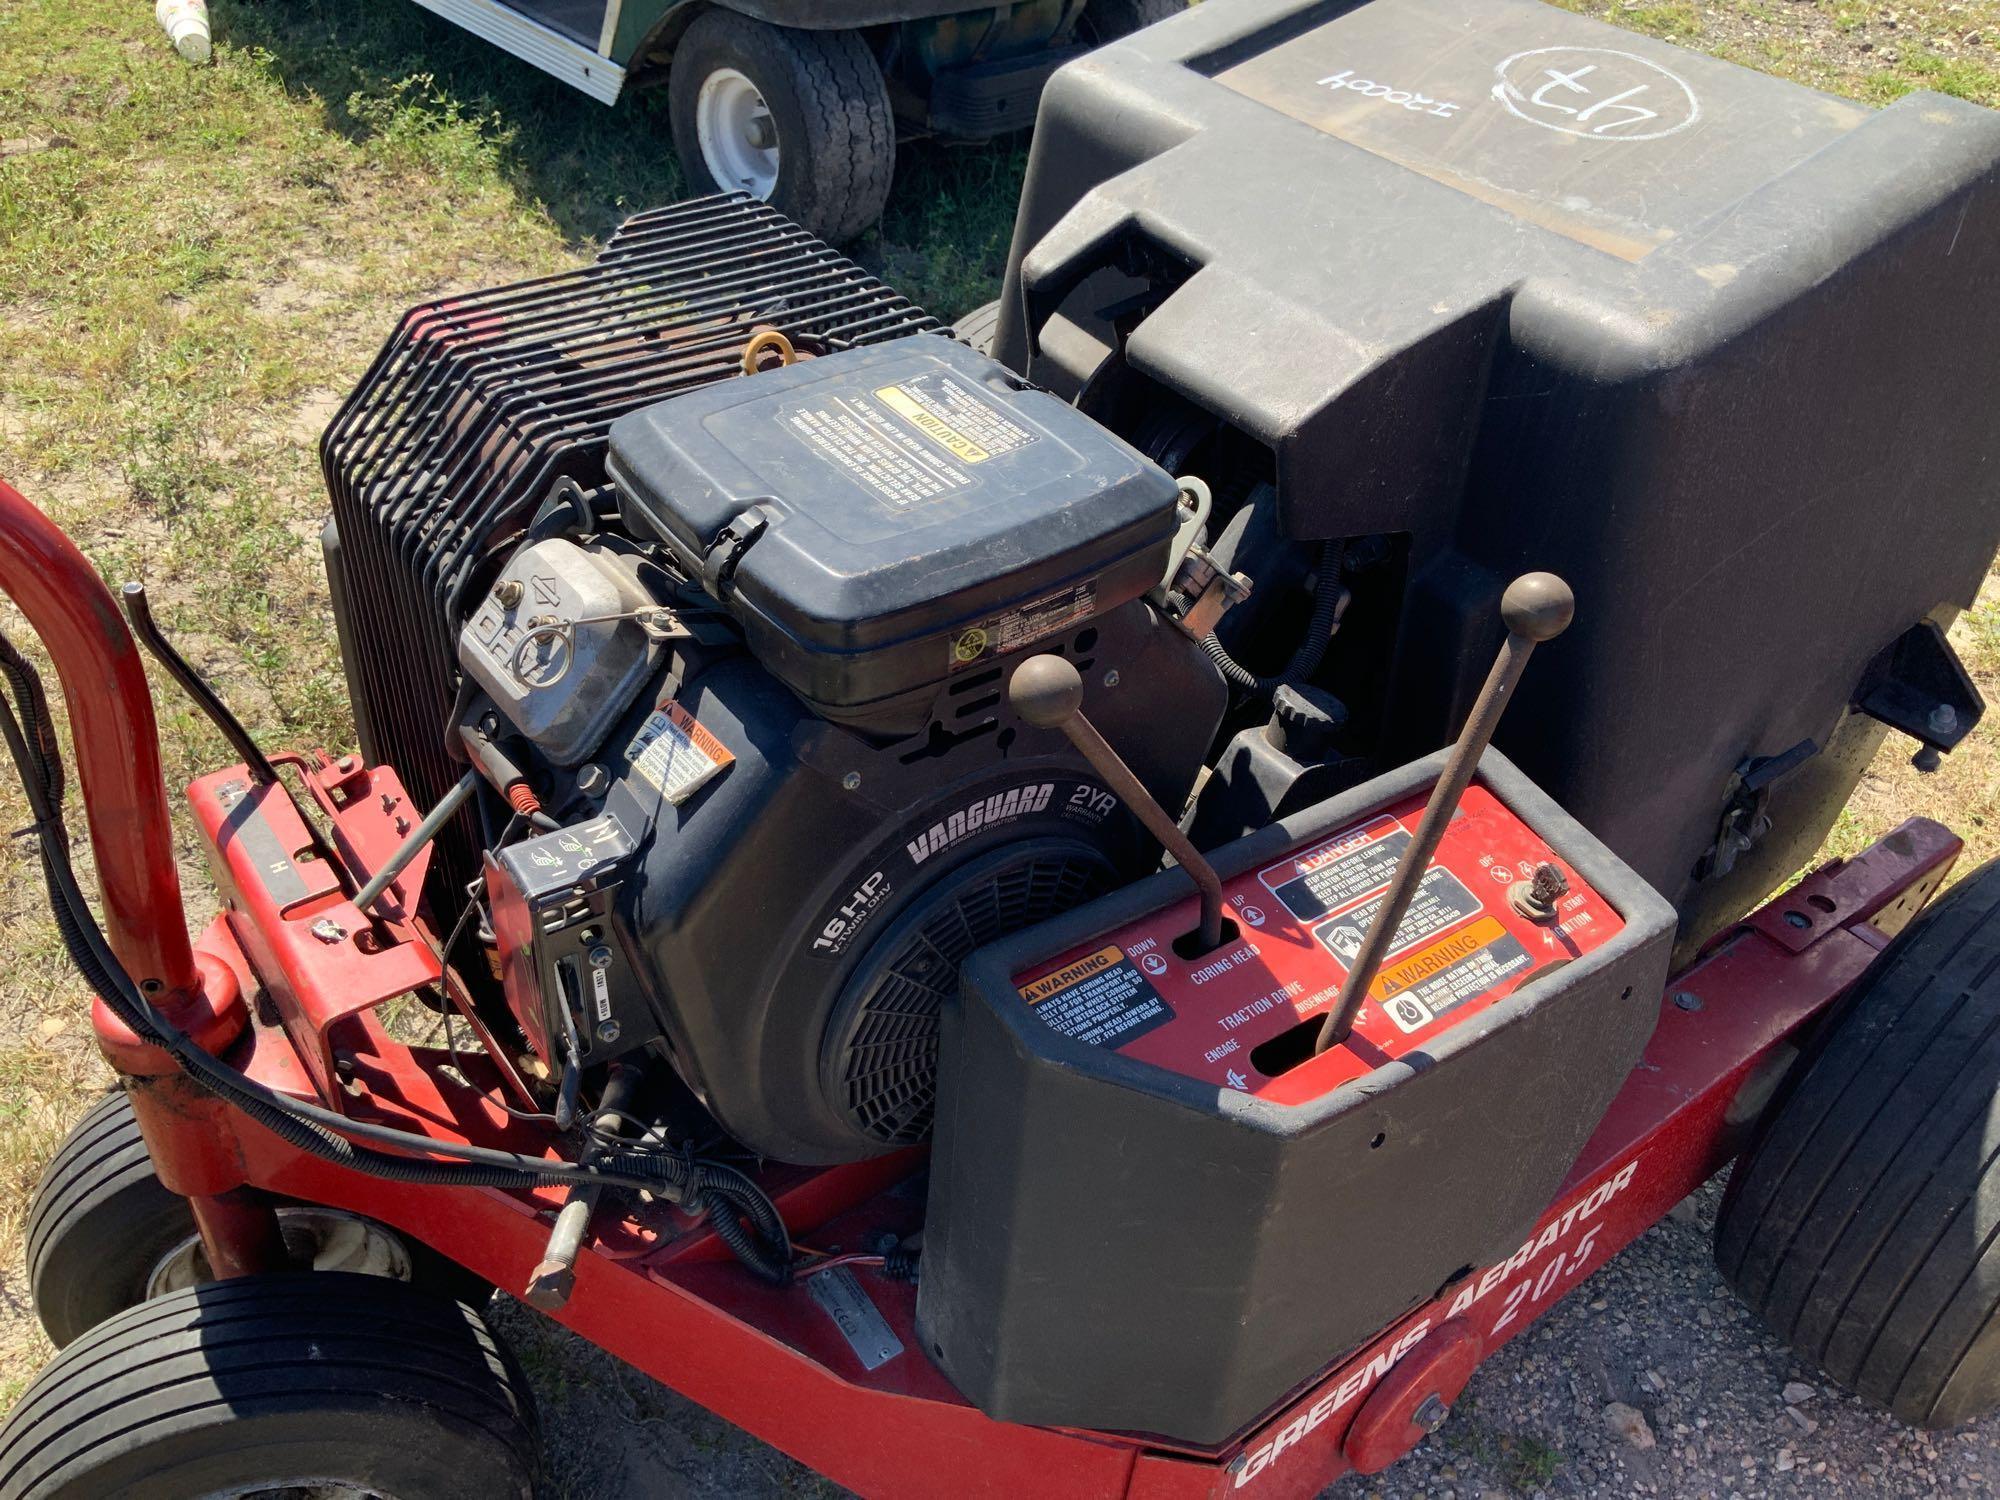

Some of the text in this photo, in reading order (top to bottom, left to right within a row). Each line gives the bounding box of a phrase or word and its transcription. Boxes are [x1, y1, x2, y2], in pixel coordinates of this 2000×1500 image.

[788, 417, 816, 434] DURING
[795, 408, 824, 427] HANDLE
[814, 410, 845, 430] KEEPING
[865, 410, 887, 422] GEAR
[881, 422, 901, 433] LOW
[819, 426, 847, 444] CLUTCH
[839, 429, 864, 444] WHILE
[903, 437, 925, 450] HEAD
[912, 413, 968, 449] CAUTION
[811, 434, 858, 466] ENCOUNTERED
[841, 443, 859, 453] THE
[854, 453, 872, 463] JOG
[859, 444, 883, 459] ALIGN
[870, 440, 900, 458] SWITCH
[919, 449, 948, 467] CORING
[877, 457, 903, 473] GEARS
[895, 458, 933, 483] INTERLOCK
[897, 473, 915, 482] THE
[941, 466, 971, 484] ENGAGE
[860, 471, 902, 499] RESISTANCE
[899, 487, 921, 500] GEAR
[928, 482, 945, 492] THE
[678, 715, 726, 761] WARNING
[1065, 803, 1104, 824] WARRANTY
[1069, 784, 1118, 817] 2YR
[906, 783, 1055, 865] VANGUARD
[1307, 831, 1372, 866] DANGER
[1478, 853, 1495, 868] OFF
[270, 861, 289, 874] H
[1304, 845, 1385, 886] STOP ENGINE BEFORE LEAVING
[1309, 862, 1368, 892] OPERATOR POSITION.
[1316, 888, 1334, 899] KEEP
[1331, 871, 1369, 891] BYSTANDERS
[1367, 863, 1385, 874] FROM
[1322, 894, 1340, 905] KEEP
[1338, 889, 1351, 898] ALL
[1349, 878, 1374, 892] GUARDS
[1409, 888, 1430, 901] CHINE.
[1232, 894, 1246, 908] UP
[1351, 909, 1368, 920] READ
[1420, 872, 1443, 885] BEFORE
[1416, 896, 1440, 910] AVAILABLE
[1562, 893, 1587, 912] START
[813, 916, 846, 951] 16
[845, 870, 886, 919] HP
[830, 907, 868, 955] V-TWIN
[868, 882, 894, 910] OHV
[1403, 925, 1415, 933] THE
[1414, 917, 1429, 927] TORO
[1438, 906, 1452, 915] 8111
[1413, 912, 1424, 920] AND
[1422, 904, 1439, 915] SERIAL
[1434, 917, 1445, 925] MN
[1443, 909, 1461, 920] 55420
[1550, 910, 1593, 940] IGNITION
[1127, 937, 1157, 958] DOWN
[1396, 933, 1480, 985] WARNING
[1036, 954, 1109, 994] WARNING
[1190, 943, 1261, 986] CORING HEAD
[1040, 969, 1138, 1020] ULLY UP FOR TRANSPORT AND
[1060, 989, 1080, 1001] HAVE
[1078, 976, 1105, 992] CORING
[1103, 967, 1123, 979] HEAD
[1416, 986, 1431, 997] THE
[1429, 976, 1448, 990] NOISE
[1446, 965, 1468, 981] RATING
[1423, 985, 1451, 1004] MACHINE
[1449, 972, 1475, 990] EXCEEDS
[1430, 993, 1457, 1012] HEARING
[1454, 974, 1490, 998] PROTECTION
[1487, 971, 1497, 979] IS
[1493, 953, 1529, 976] NECESSARY.
[1046, 1015, 1064, 1027] ULLY
[1063, 1004, 1085, 1018] DOWN
[1084, 994, 1106, 1008] WHEN
[1131, 976, 1143, 984] SO
[1053, 988, 1138, 1033] FETY INTERLOCK SYSTEM
[1102, 1016, 1123, 1029] HEAD
[1121, 1002, 1150, 1020] LOWERS
[1148, 997, 1160, 1006] BY
[1217, 980, 1306, 1032] TRACTION DRIVE
[1064, 1002, 1129, 1037] CTIONS PROPERLY.
[1103, 1005, 1165, 1038] FIX BEFORE USING.
[1204, 1038, 1241, 1064] ENGAGE
[1489, 1222, 1604, 1337] 205
[1234, 1160, 1639, 1490] GREENS AERATOR
